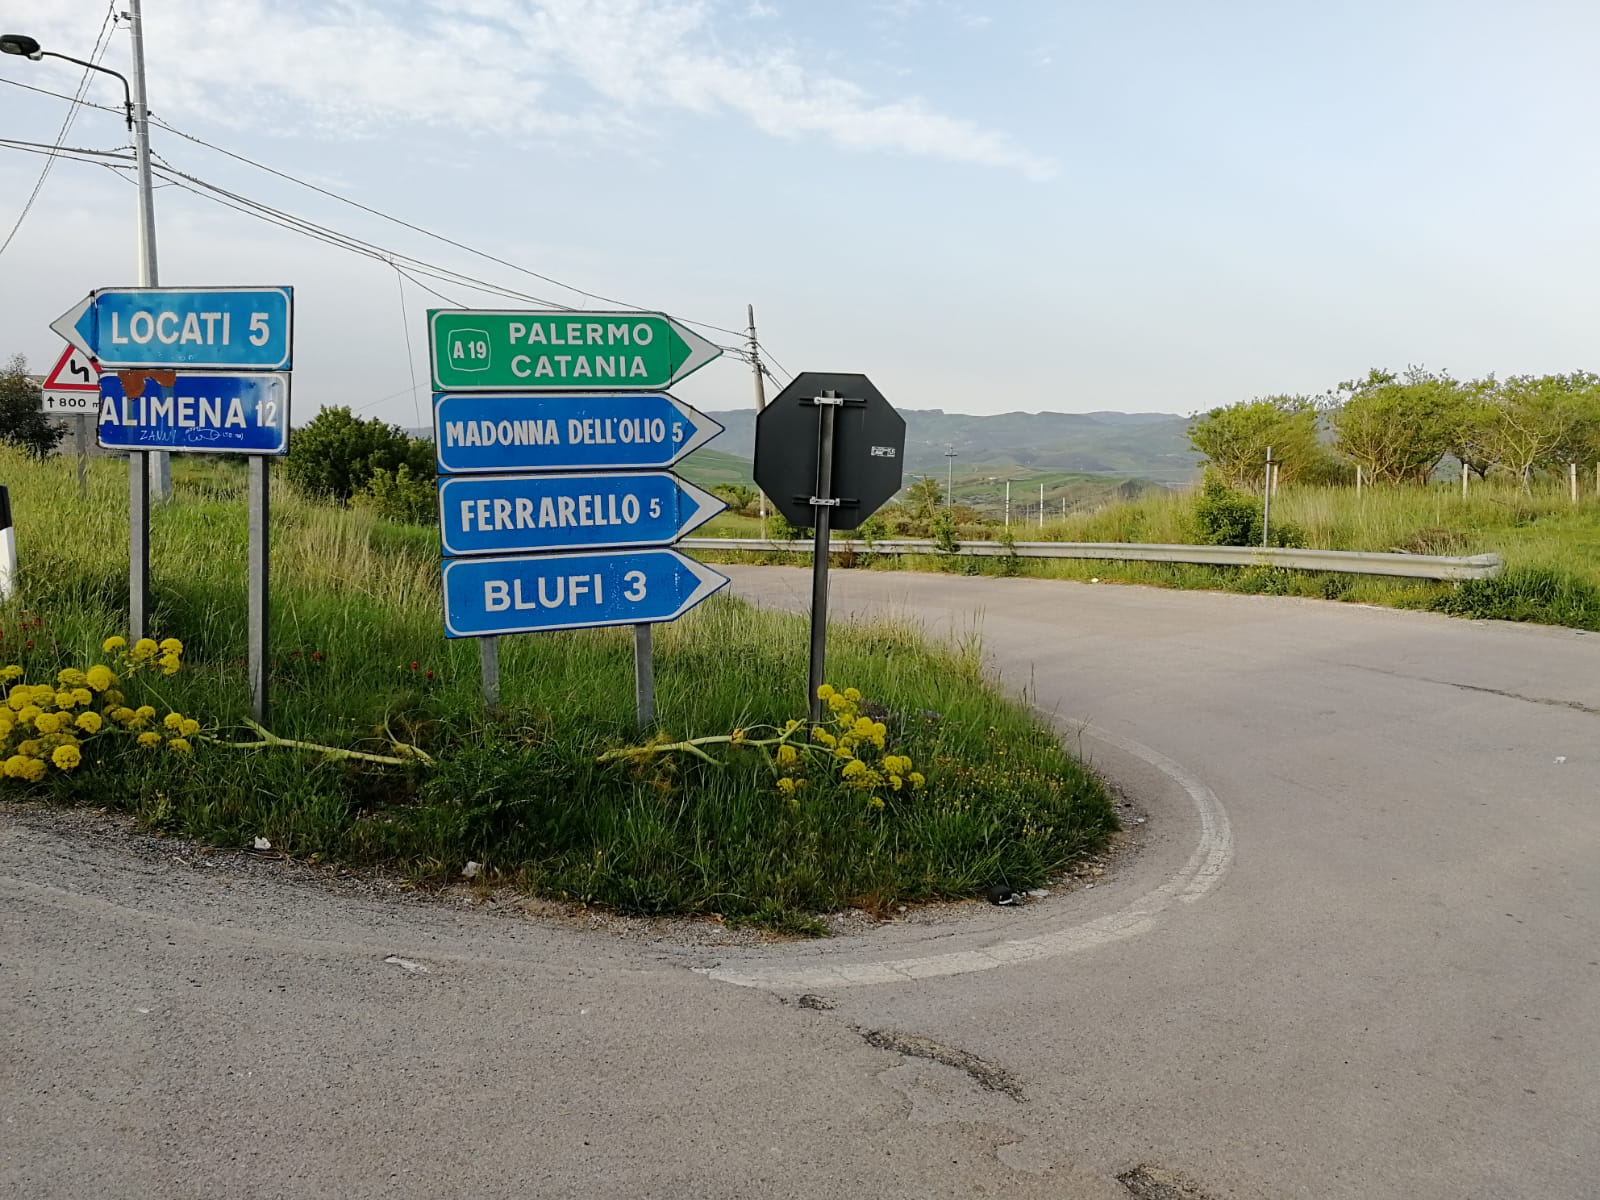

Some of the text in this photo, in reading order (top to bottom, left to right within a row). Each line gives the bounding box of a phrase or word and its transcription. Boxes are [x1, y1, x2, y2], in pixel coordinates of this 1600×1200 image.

[111, 311, 270, 346] LOCATI 5
[509, 322, 653, 346] PALERMO
[453, 341, 487, 359] A 19
[511, 355, 648, 377] CATANIA
[59, 398, 86, 408] 800
[99, 396, 277, 428] ALIMENA 12
[446, 417, 684, 447] MADONNA DELL'OLIO 5
[460, 494, 661, 532] FERRARELLO 5
[484, 570, 647, 612] BLUFI 3
